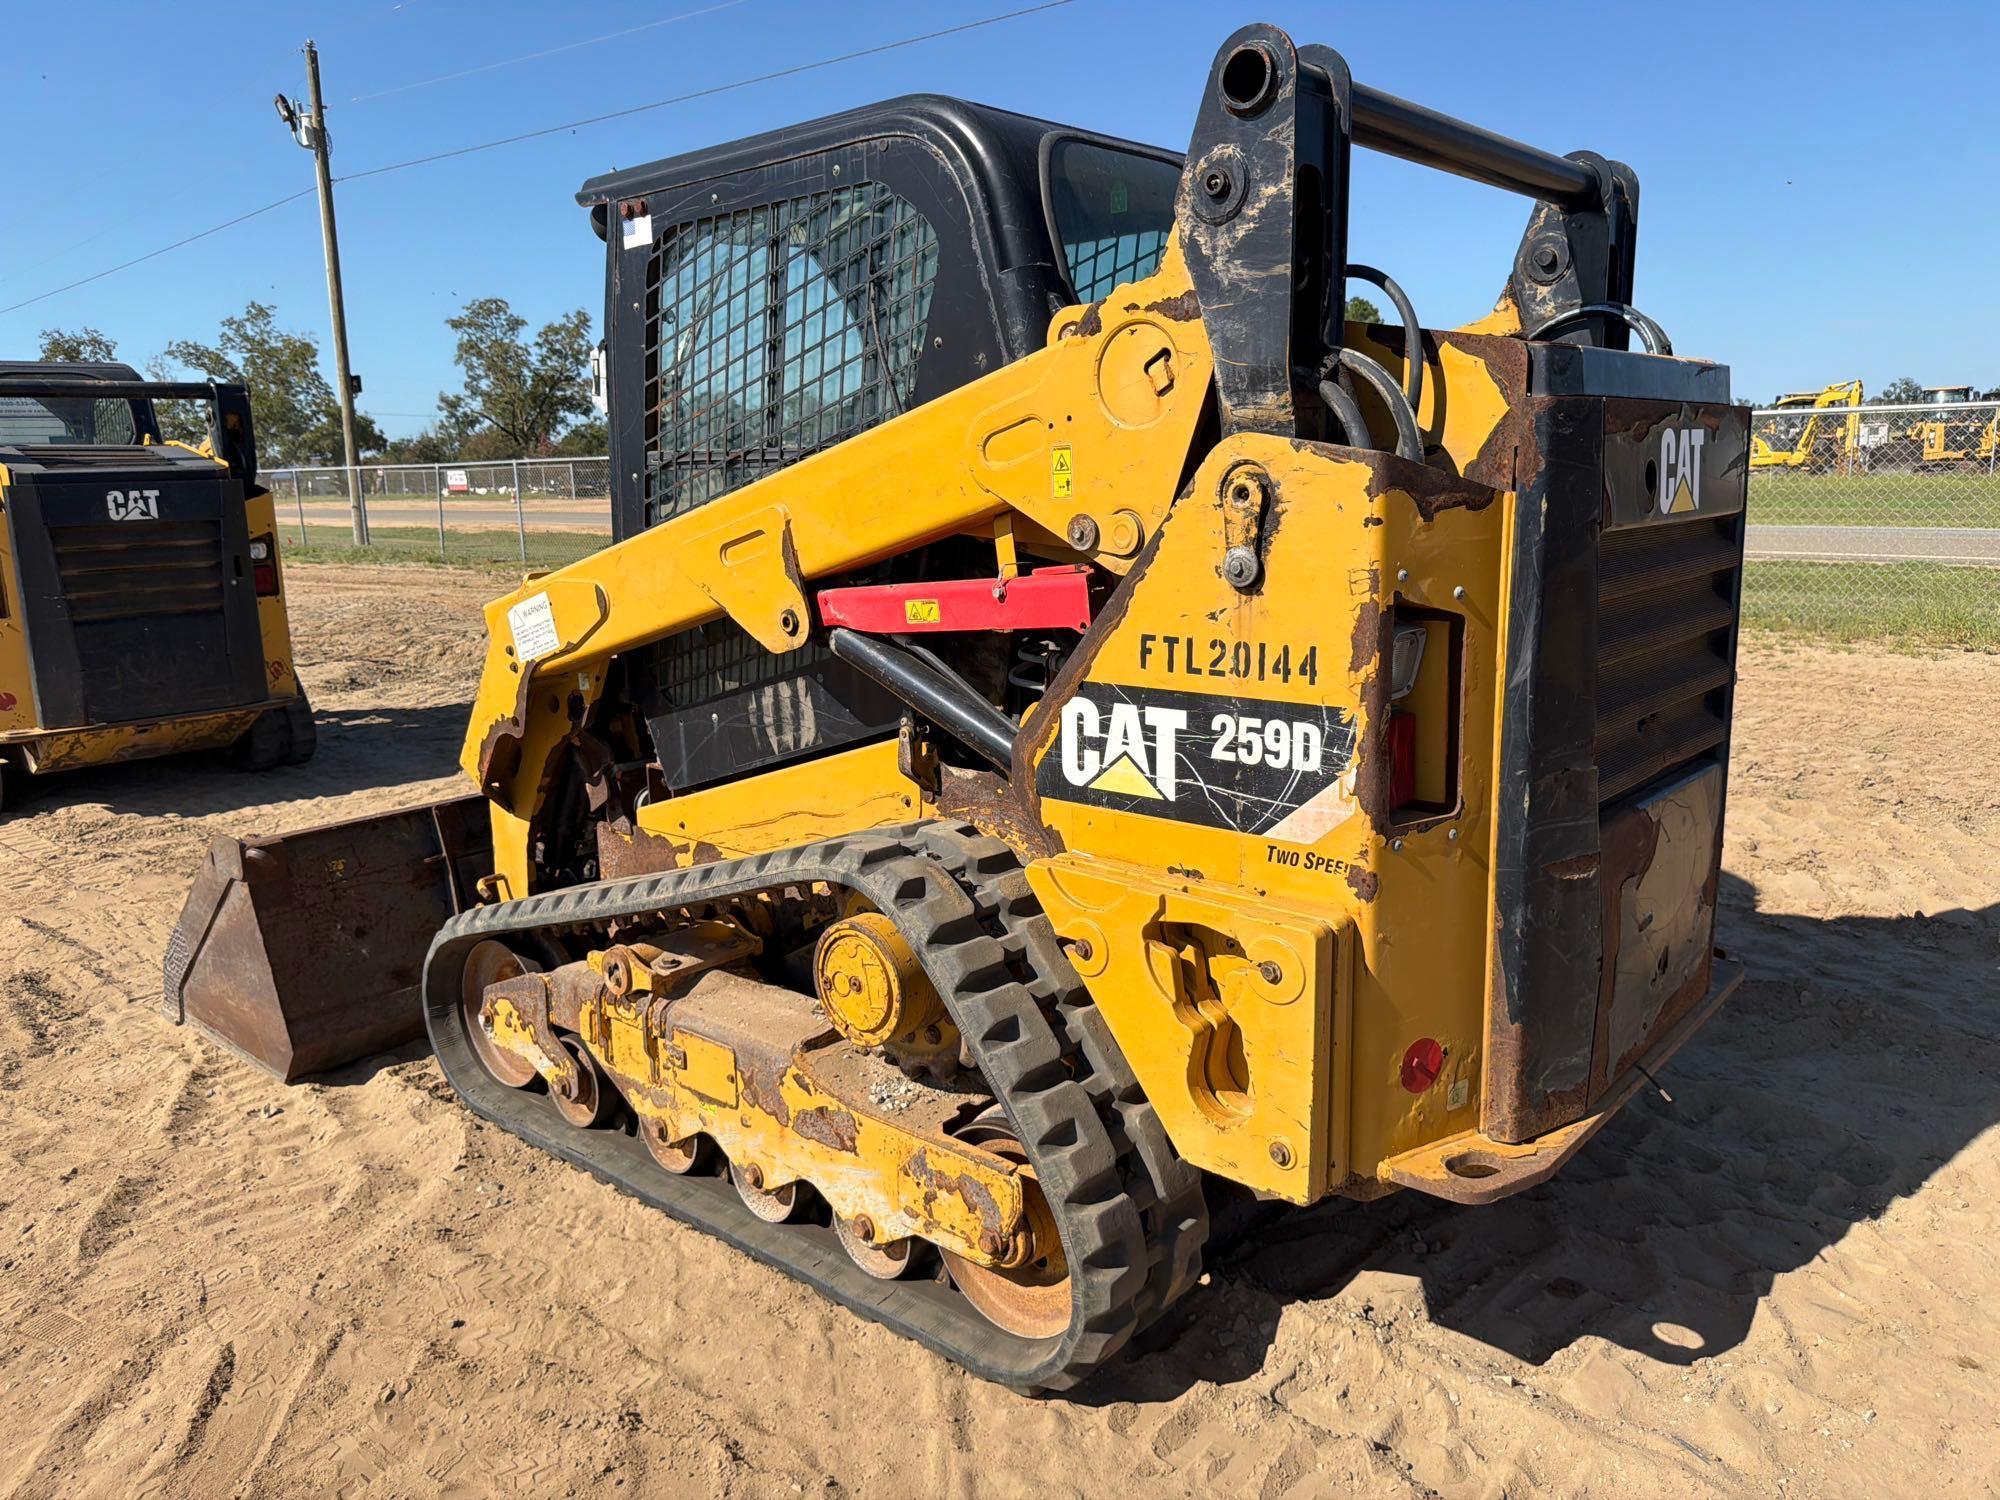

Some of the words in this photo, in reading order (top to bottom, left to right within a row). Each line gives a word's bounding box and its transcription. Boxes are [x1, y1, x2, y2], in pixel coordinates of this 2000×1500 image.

[106, 489, 160, 520] CAT
[1660, 427, 1704, 514] CAT
[1140, 633, 1318, 686] FTL20144
[1060, 696, 1187, 802] CAT
[1211, 713, 1322, 773] 259D
